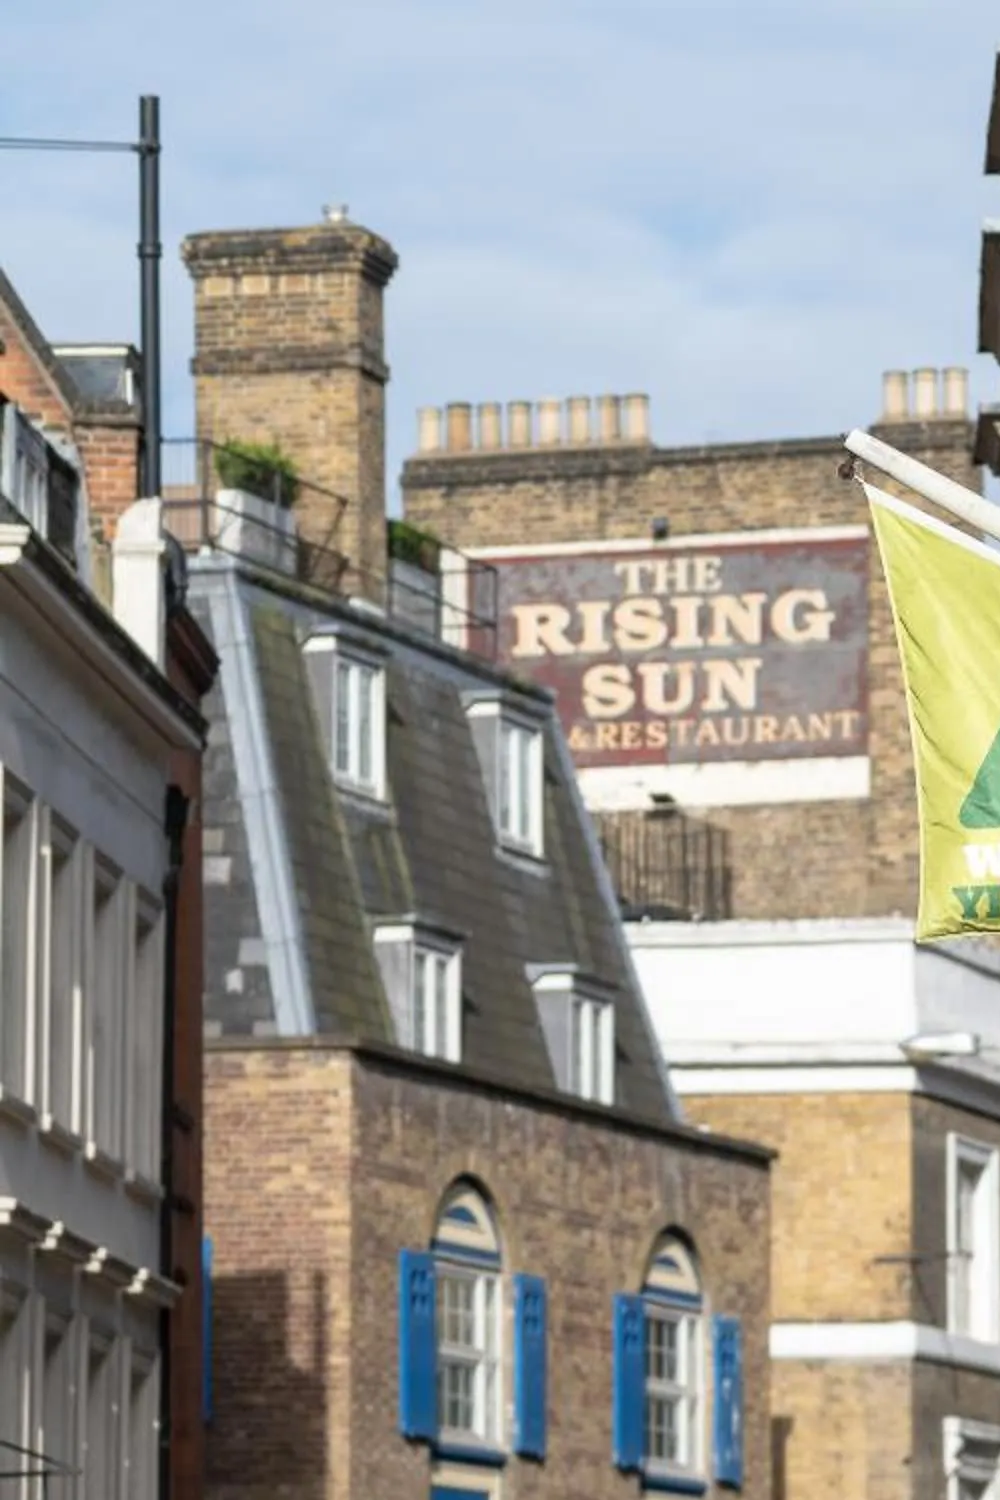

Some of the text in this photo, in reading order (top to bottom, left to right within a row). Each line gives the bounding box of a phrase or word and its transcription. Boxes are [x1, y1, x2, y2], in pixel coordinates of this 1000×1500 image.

[615, 557, 722, 593] THE
[511, 588, 835, 657] RISING
[582, 658, 762, 718] SUN
